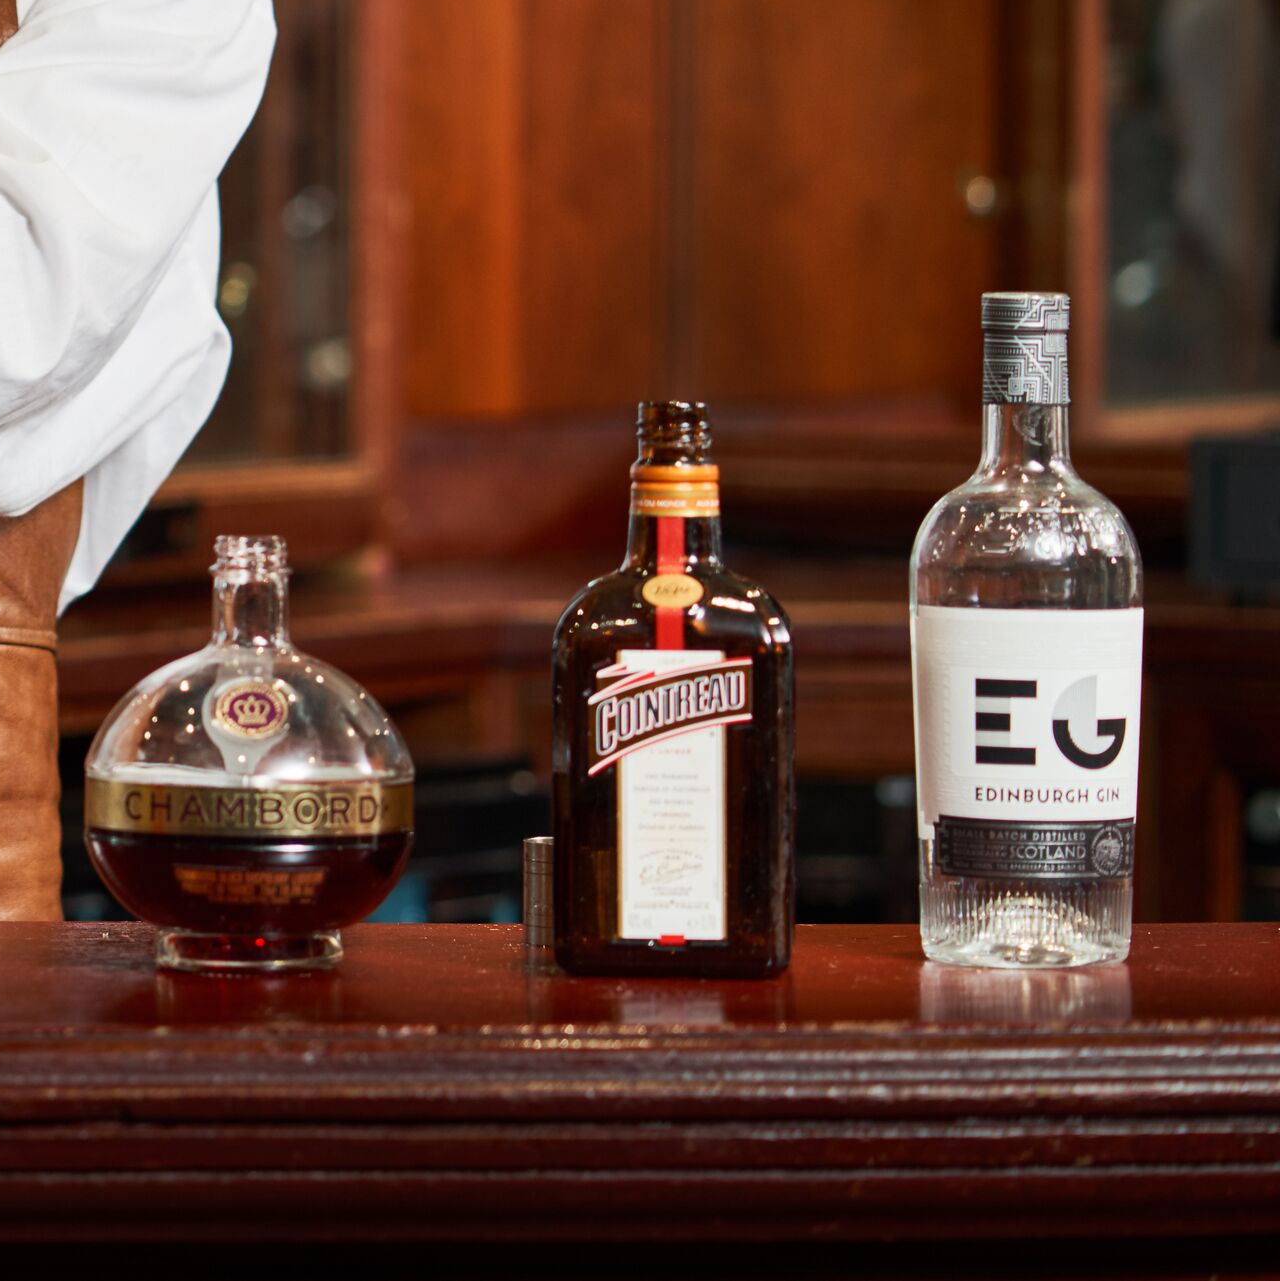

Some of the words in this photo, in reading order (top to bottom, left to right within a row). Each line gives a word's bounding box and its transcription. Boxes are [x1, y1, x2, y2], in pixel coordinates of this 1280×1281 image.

[596, 670, 746, 756] COINTREAU
[975, 675, 1127, 769] EG
[975, 787, 1089, 803] EDINBURGH
[1096, 786, 1121, 802] GIN
[124, 790, 379, 826] CHAMBORD
[989, 831, 1028, 842] BATCH
[1032, 832, 1086, 842] DISTILLED
[1009, 843, 1087, 860] SCOTLAND
